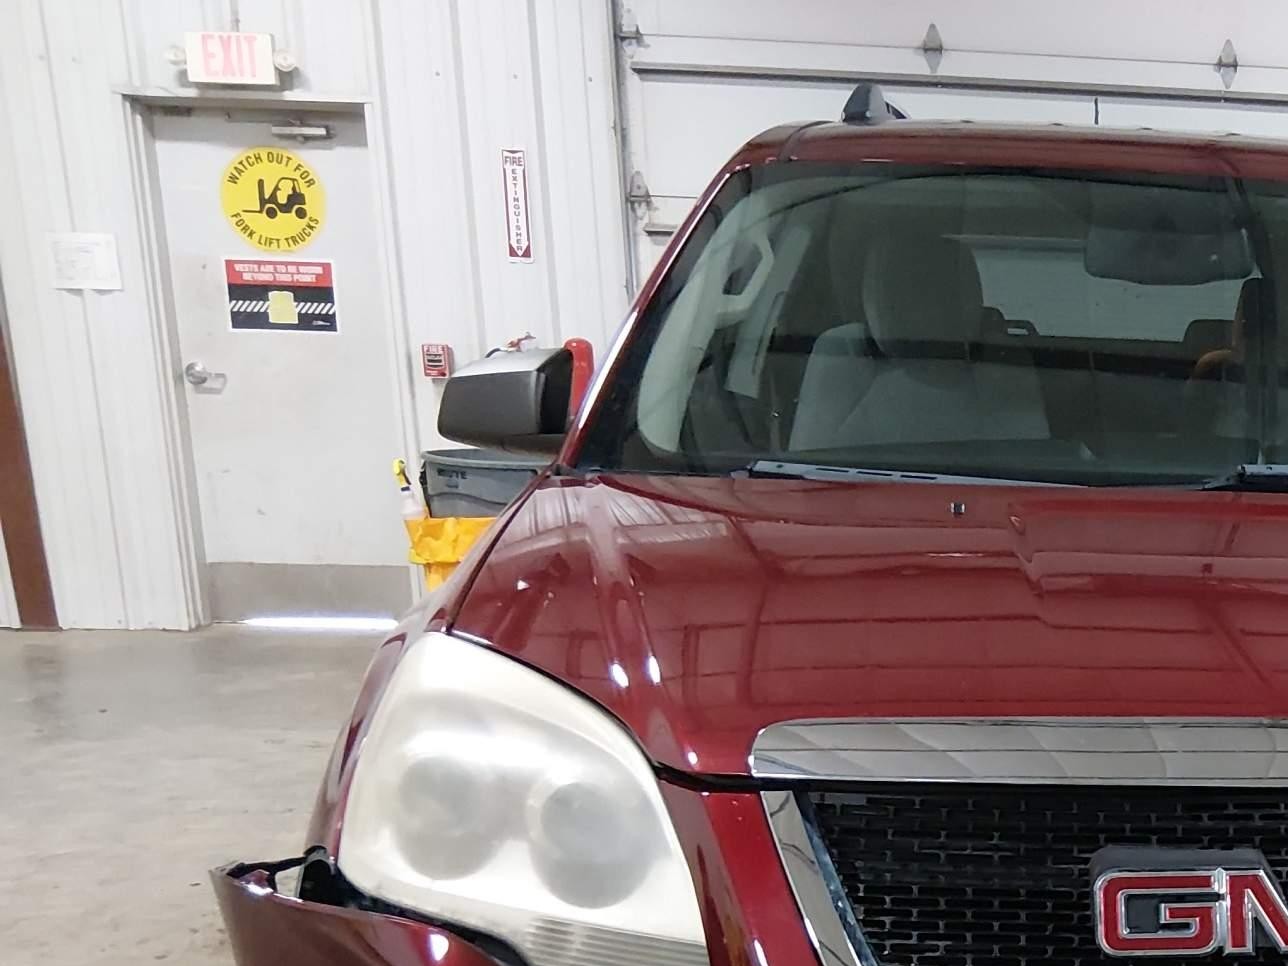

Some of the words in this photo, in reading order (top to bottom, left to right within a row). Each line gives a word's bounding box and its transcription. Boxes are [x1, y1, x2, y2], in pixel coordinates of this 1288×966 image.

[201, 33, 257, 78] EXIT
[227, 152, 263, 185] WATCH
[267, 151, 293, 167] OUT
[294, 163, 316, 188] FOR
[504, 155, 523, 167] FIRE
[230, 212, 256, 240] FORK
[258, 234, 281, 249] LIFT
[284, 216, 320, 248] TRUCKS
